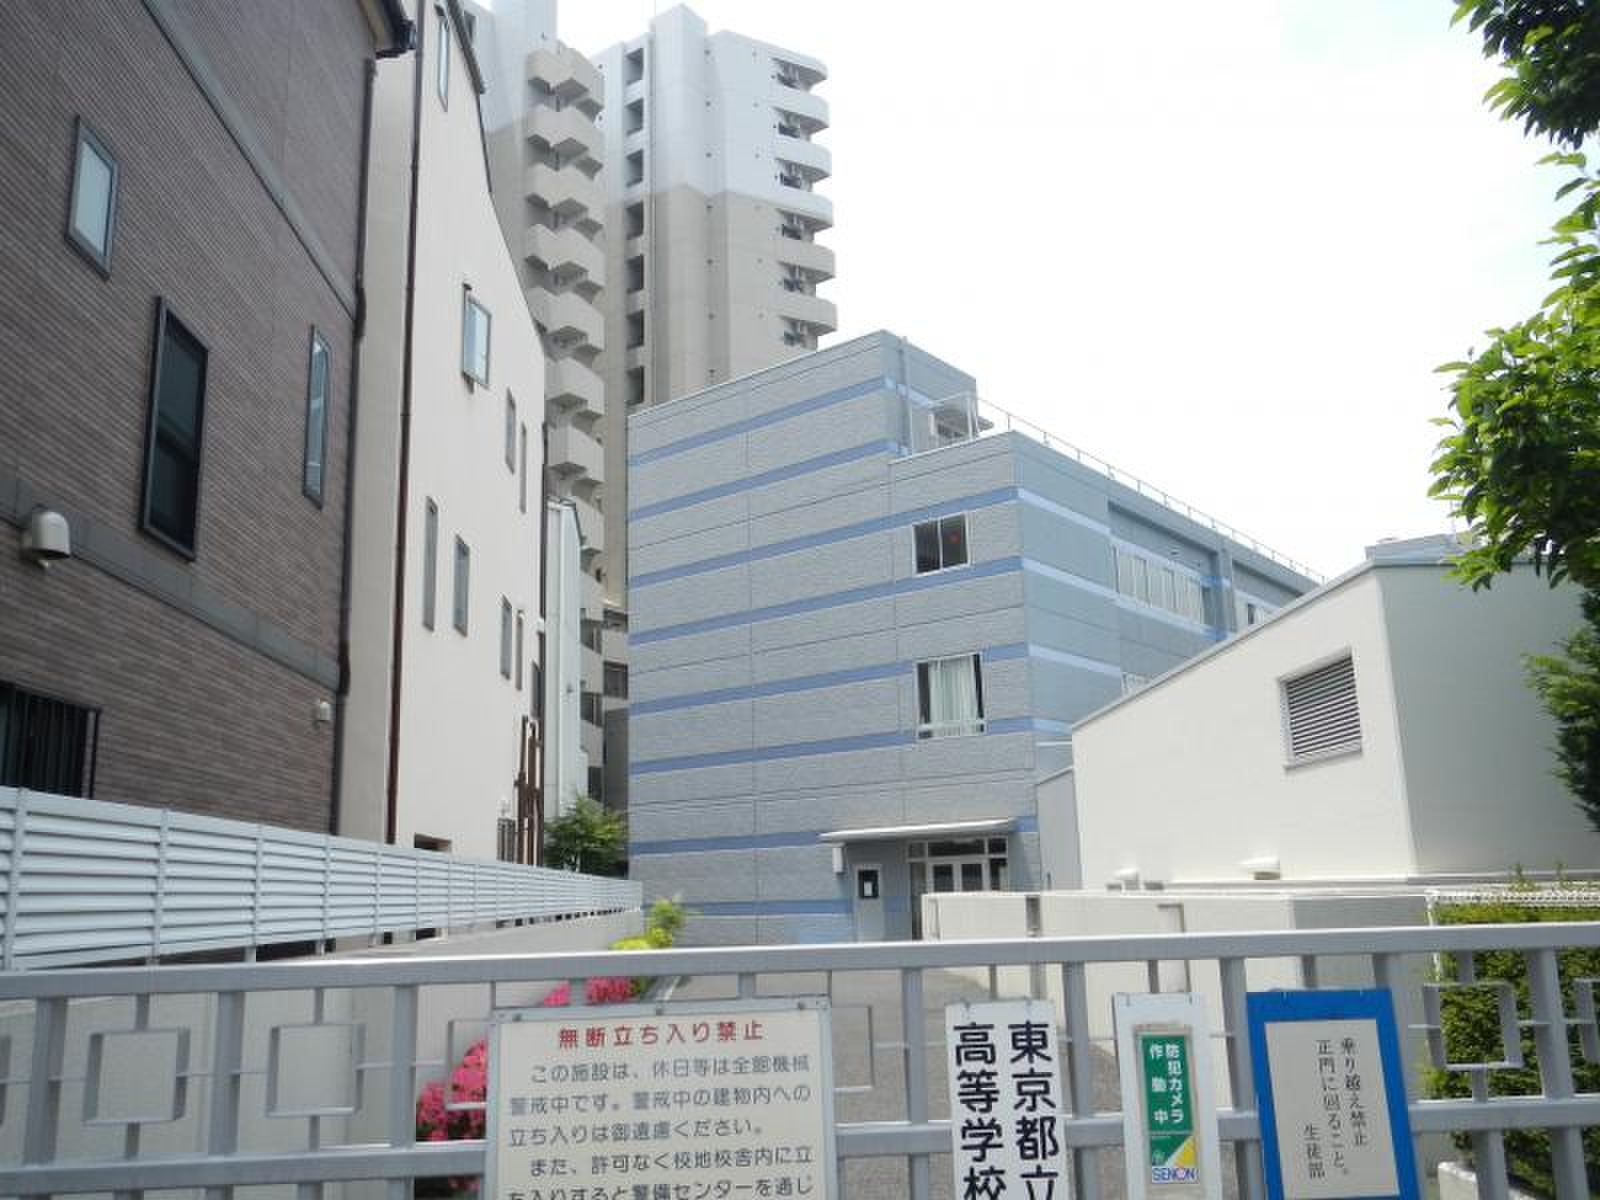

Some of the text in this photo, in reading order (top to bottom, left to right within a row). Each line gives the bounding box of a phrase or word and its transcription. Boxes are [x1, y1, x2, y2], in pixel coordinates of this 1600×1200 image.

[558, 1020, 765, 1049] 無断立ち入り禁止
[1149, 1044, 1168, 1124] 作動中
[1165, 1044, 1184, 1123] 防犯カメラ
[953, 1021, 1007, 1200] 高等学校
[1007, 1020, 1060, 1200] 東京都立
[1315, 1039, 1349, 1175] 正門に回ること。
[1340, 1037, 1368, 1146] 乗り越え禁止
